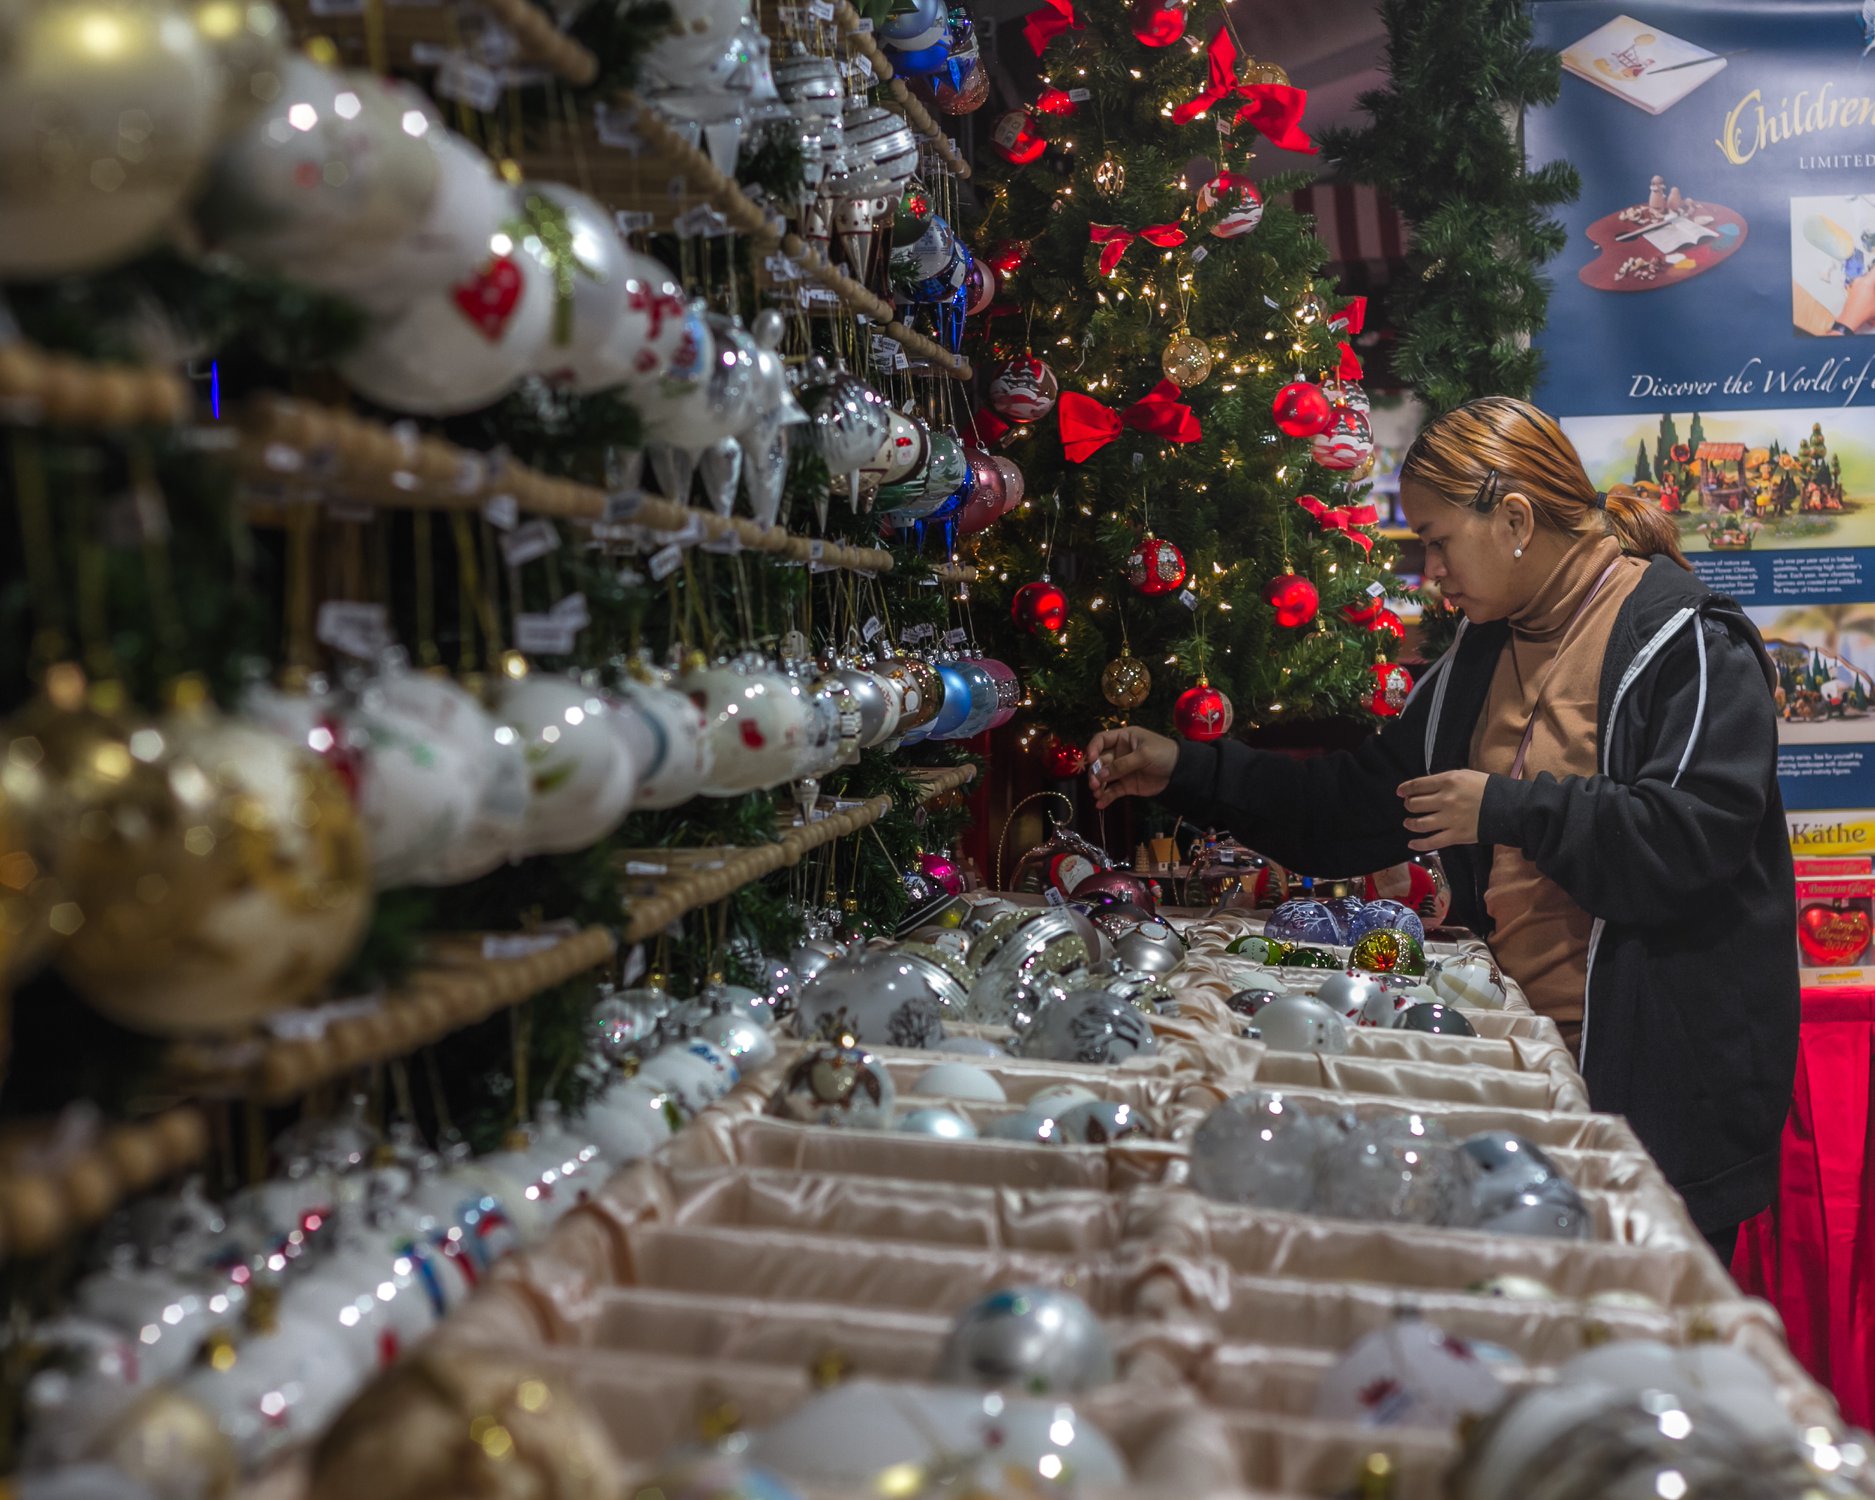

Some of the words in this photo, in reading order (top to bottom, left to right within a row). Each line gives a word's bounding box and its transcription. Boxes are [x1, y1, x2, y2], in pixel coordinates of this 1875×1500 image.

[1715, 81, 1875, 165] Children
[1800, 154, 1875, 169] LIMITED
[1629, 374, 1717, 397] Discover
[1723, 357, 1761, 394] the
[1763, 357, 1850, 393] World
[1842, 357, 1875, 407] of
[1792, 822, 1866, 844] Käthe
